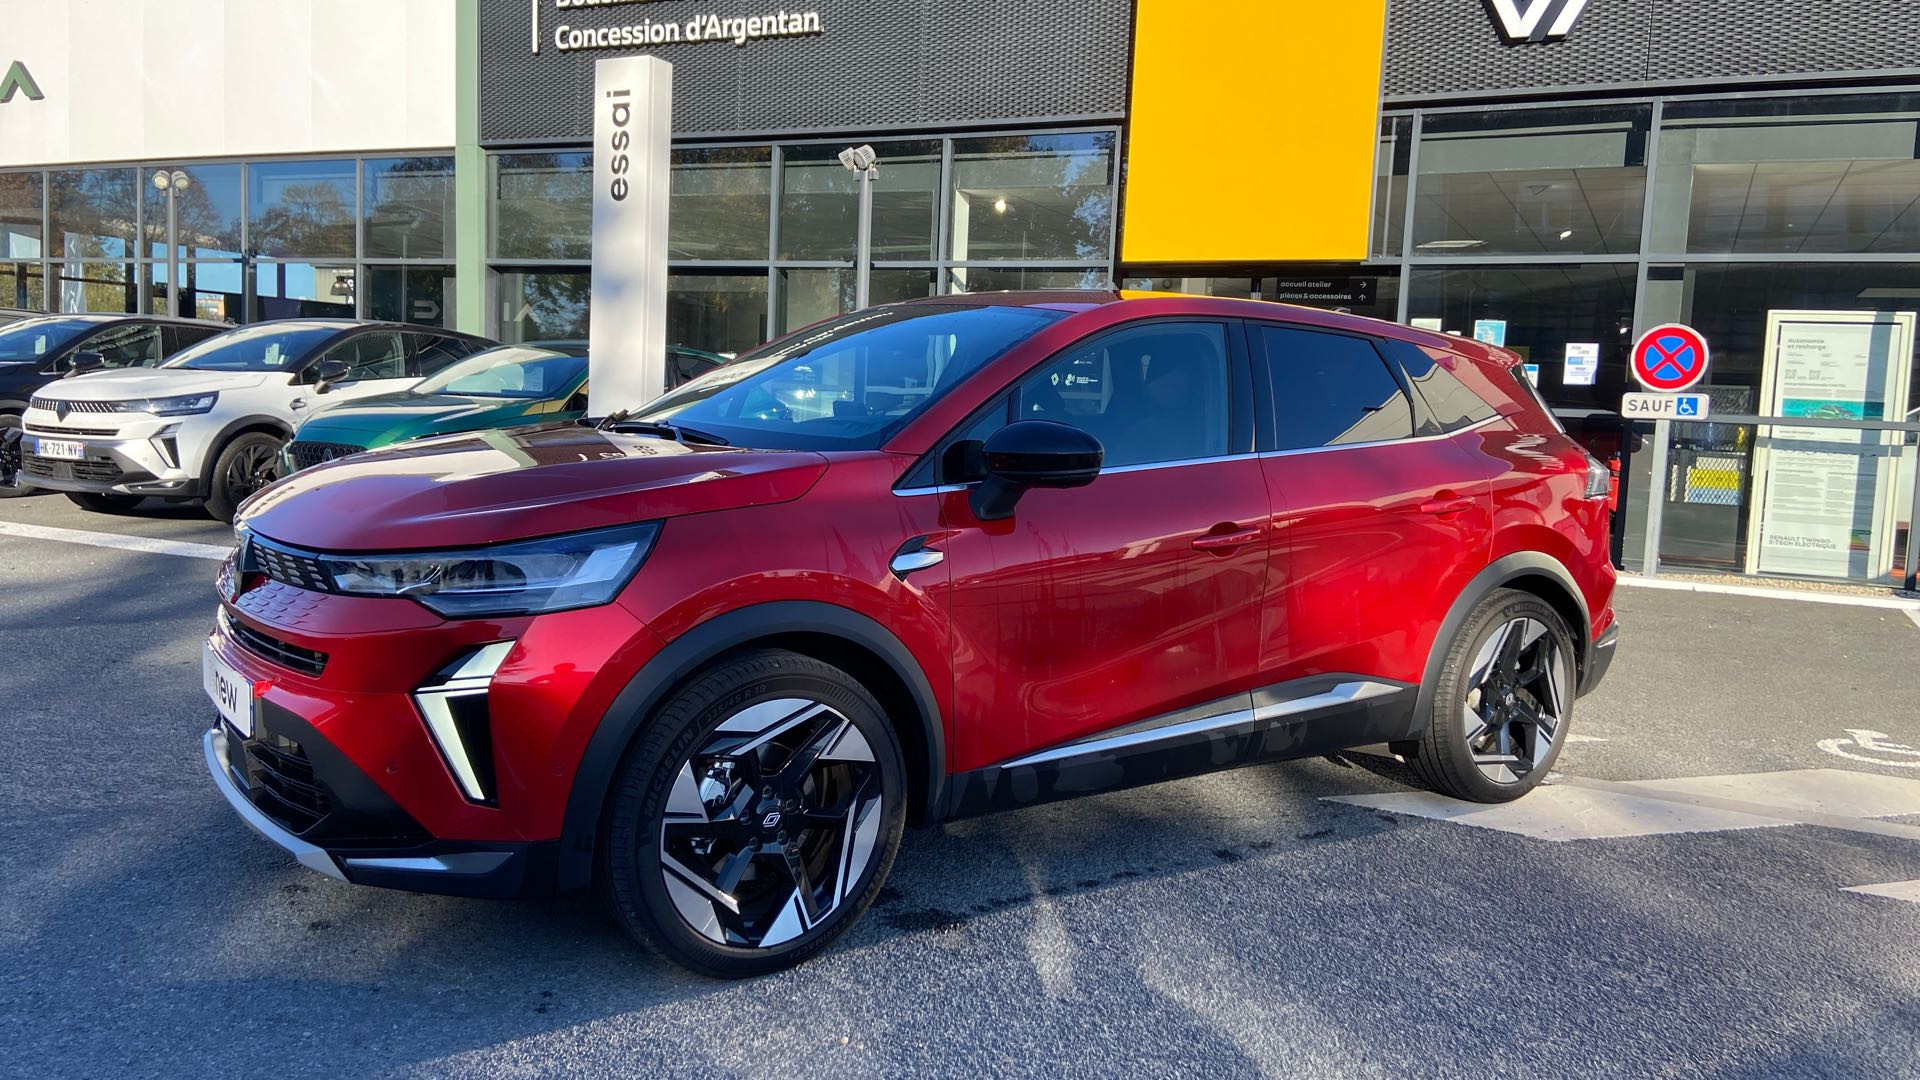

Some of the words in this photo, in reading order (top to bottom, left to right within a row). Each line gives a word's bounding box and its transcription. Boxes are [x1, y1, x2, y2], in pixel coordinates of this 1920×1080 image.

[555, 19, 680, 49] Concession
[686, 11, 821, 45] d'Argentan
[606, 89, 631, 201] essai
[1281, 280, 1307, 288] accueil
[1280, 292, 1303, 301] pièces
[1628, 399, 1673, 412] SAUF
[1769, 534, 1800, 542] RENAULT
[1802, 536, 1831, 544] TWINGO
[215, 671, 238, 713] new
